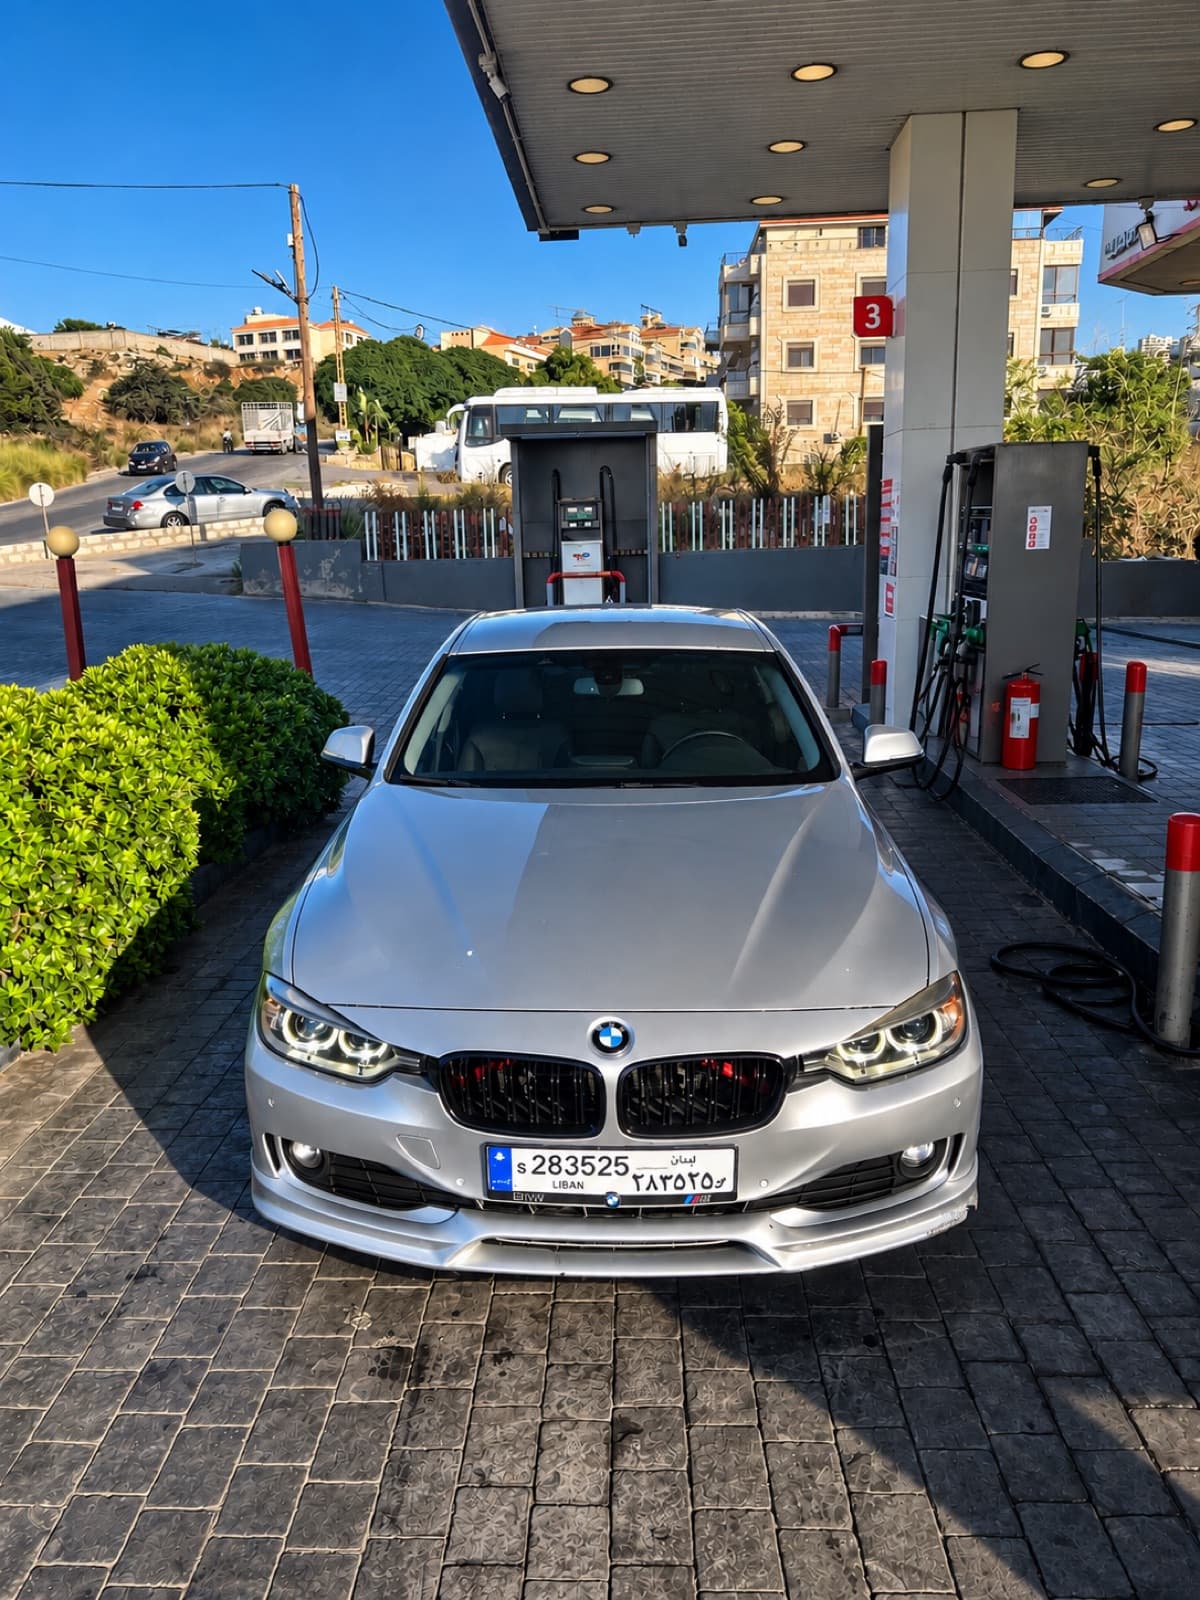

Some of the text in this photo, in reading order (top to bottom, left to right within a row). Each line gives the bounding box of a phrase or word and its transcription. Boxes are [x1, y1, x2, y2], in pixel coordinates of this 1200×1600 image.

[865, 303, 880, 329] 3
[531, 1154, 629, 1177] 283525
[671, 1154, 696, 1167] لبنان
[552, 1180, 584, 1190] LIBAN
[632, 1171, 714, 1192] ٢٨٣٥٢٥
